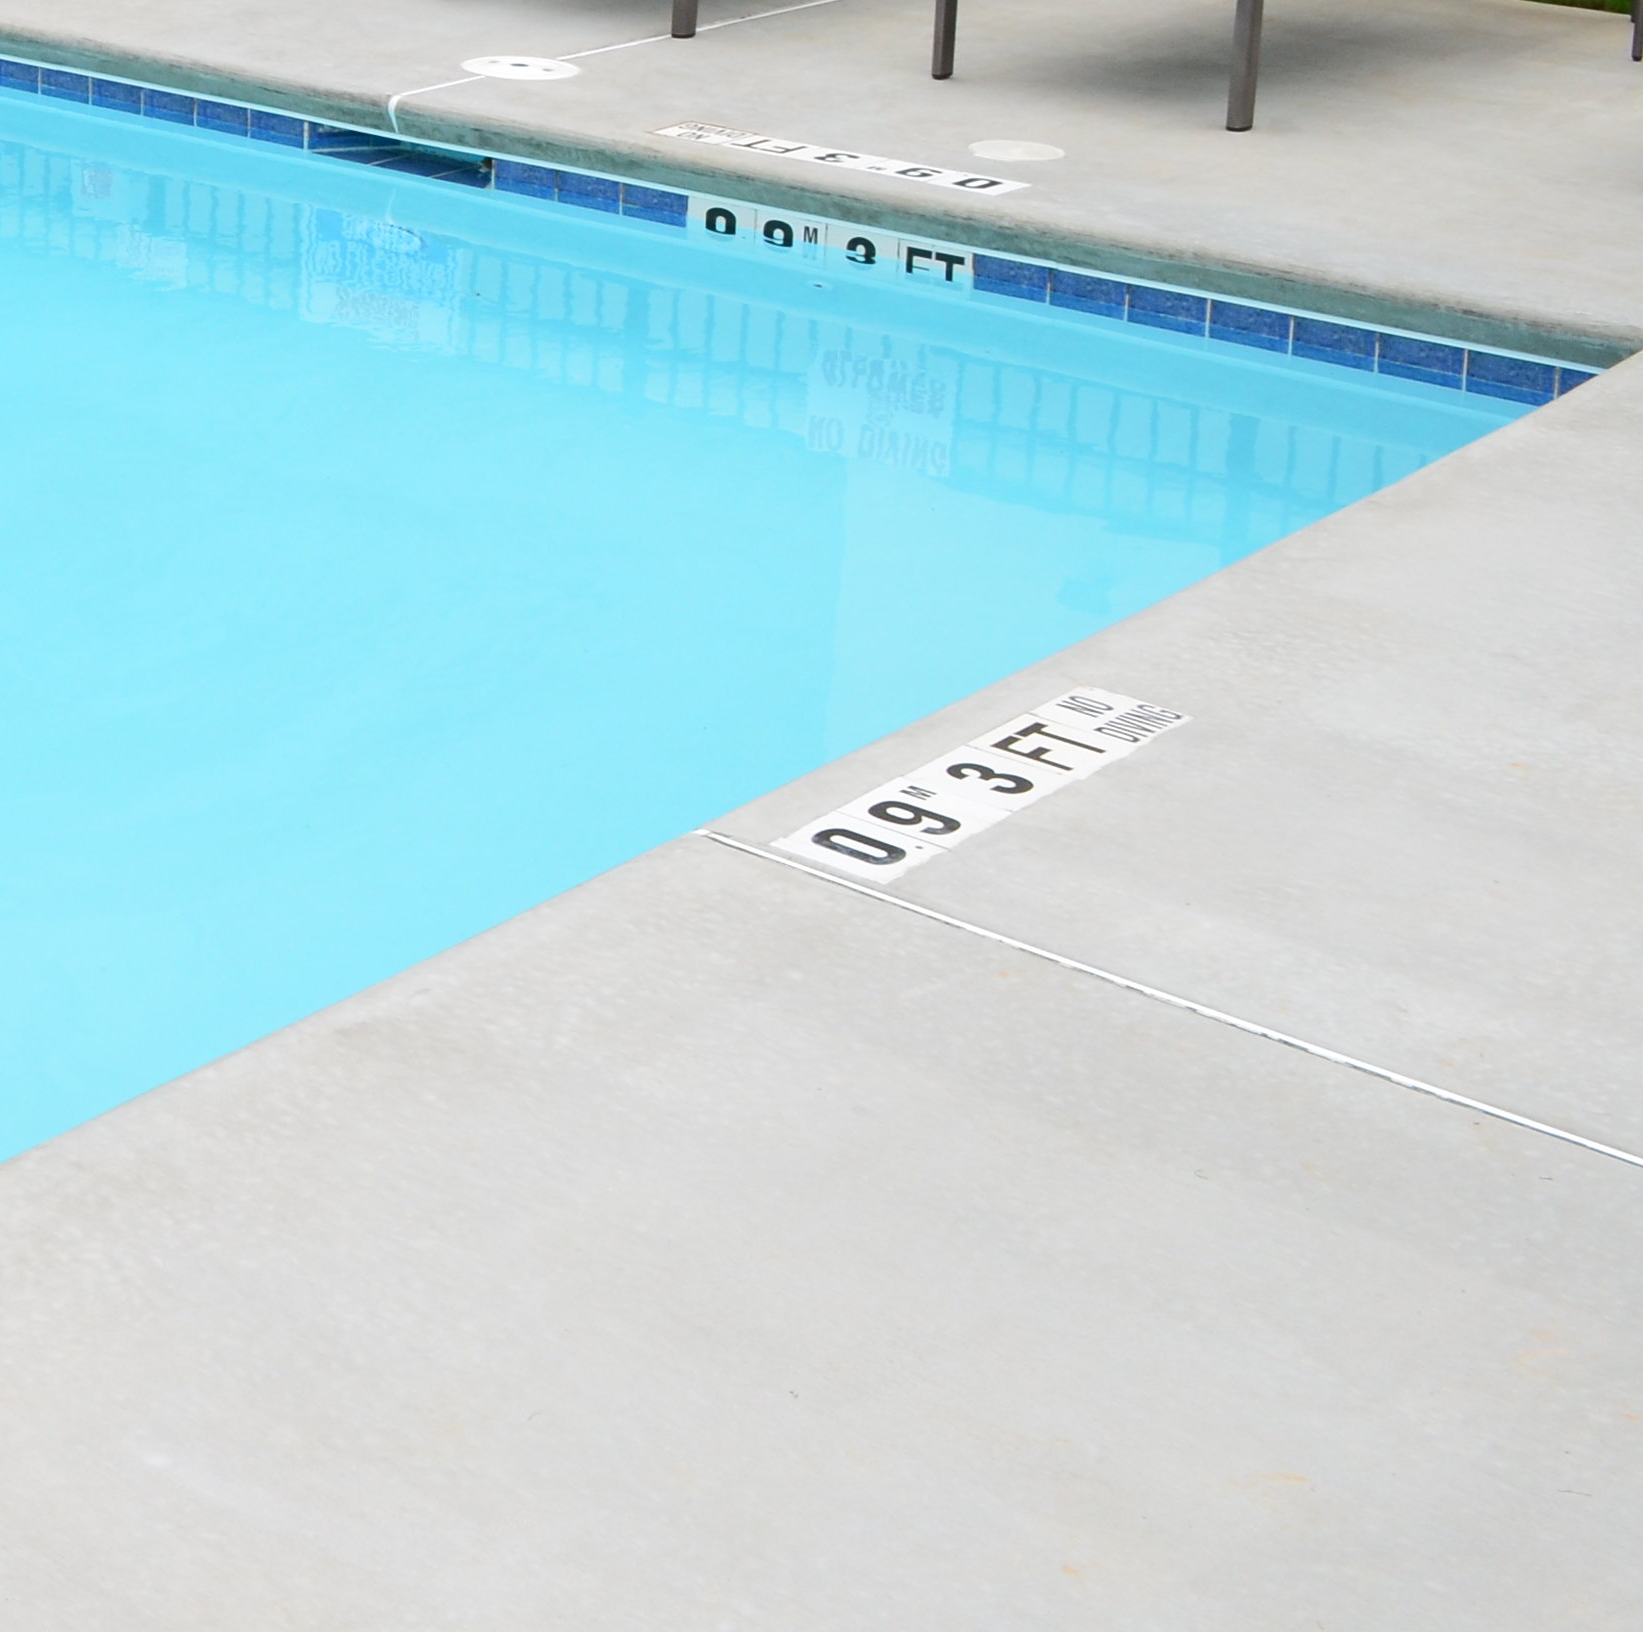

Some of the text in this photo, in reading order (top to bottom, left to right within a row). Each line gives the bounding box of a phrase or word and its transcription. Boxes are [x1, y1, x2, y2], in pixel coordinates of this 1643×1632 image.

[730, 139, 808, 154] FT
[814, 153, 860, 162] 3
[905, 246, 965, 282] FT
[1056, 695, 1114, 719] NO
[1093, 703, 1185, 744] DIVING
[946, 762, 1034, 795] 3
[990, 721, 1107, 771] FT
